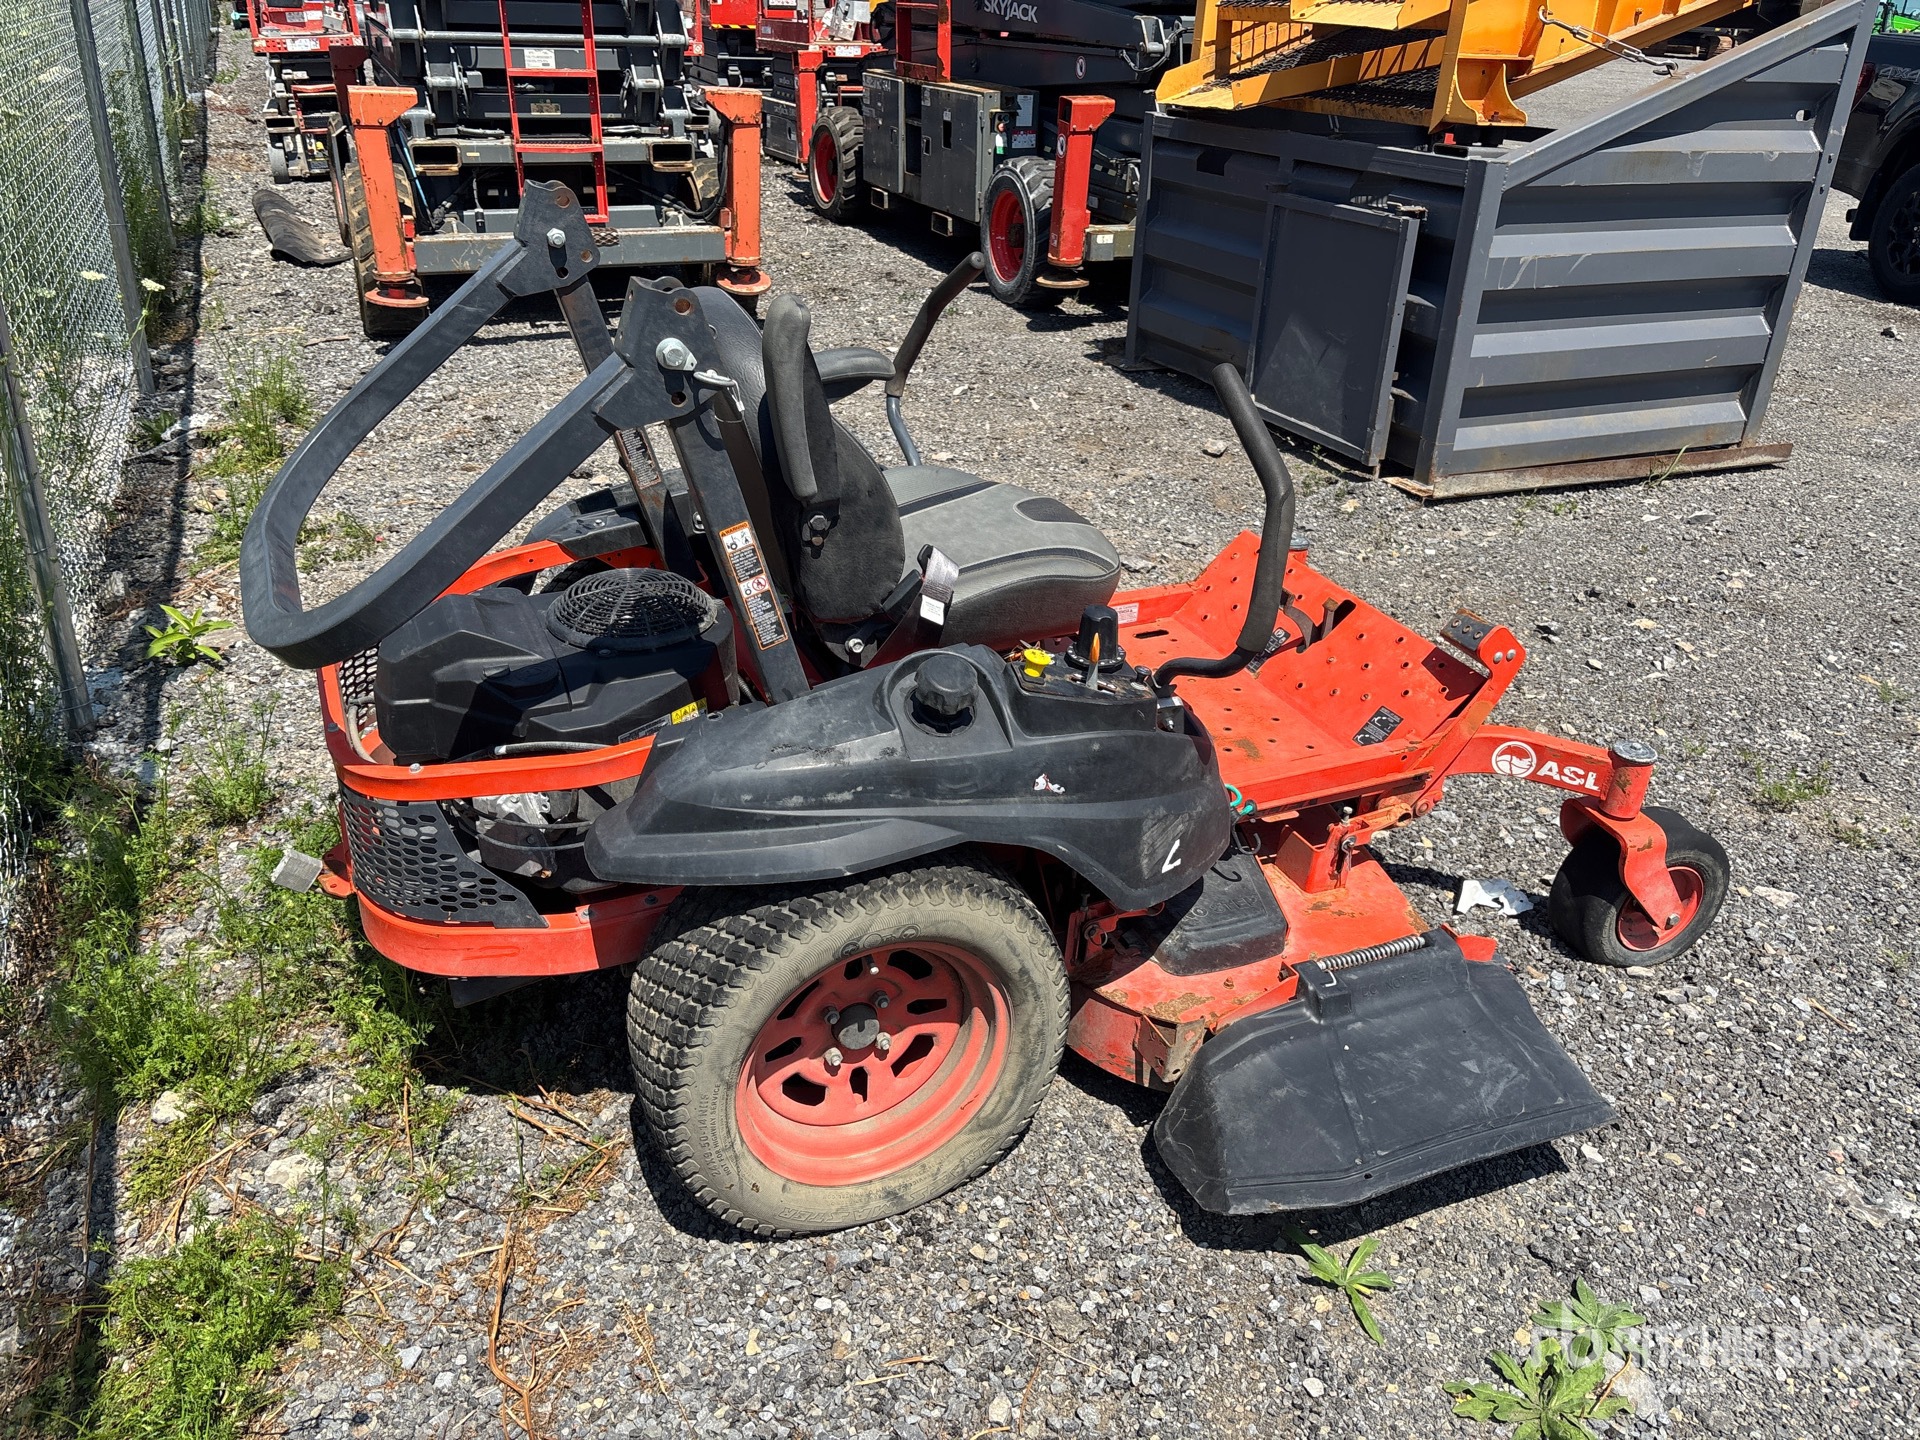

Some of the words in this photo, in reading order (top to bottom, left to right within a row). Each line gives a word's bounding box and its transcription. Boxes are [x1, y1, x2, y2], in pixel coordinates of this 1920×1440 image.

[983, 0, 1038, 23] SKYJACK
[1537, 760, 1600, 791] ASL
[710, 1083, 721, 1115] SERVICE
[710, 1118, 719, 1149] HIGHWAY
